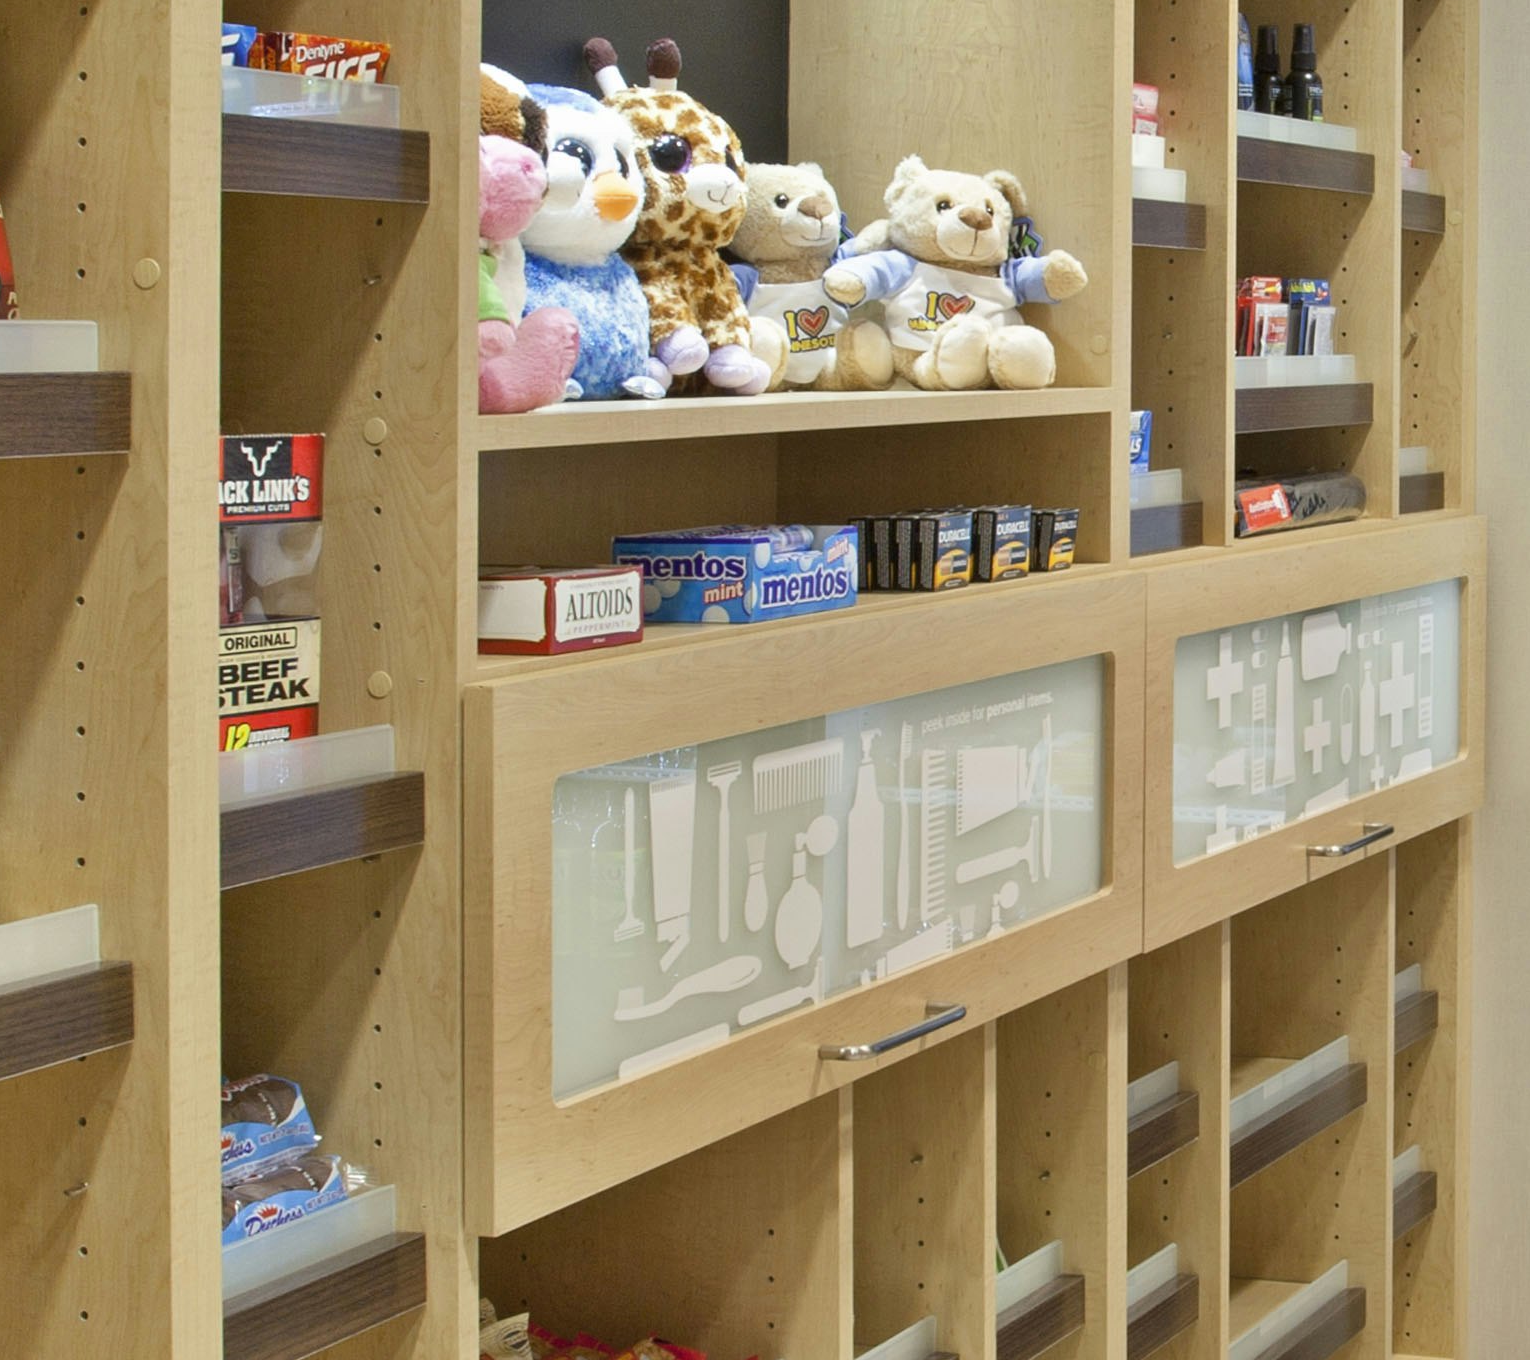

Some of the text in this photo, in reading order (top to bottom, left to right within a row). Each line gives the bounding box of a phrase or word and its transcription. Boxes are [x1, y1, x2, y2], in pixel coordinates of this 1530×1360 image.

[295, 41, 345, 63] Dentyne
[252, 475, 310, 504] LINK'S
[618, 551, 746, 583] mentos
[702, 580, 745, 605] mint
[760, 565, 849, 608] mentos
[564, 585, 634, 623] ALTOIDS
[224, 633, 291, 652] ORIGINAL
[220, 657, 299, 686] BEEF
